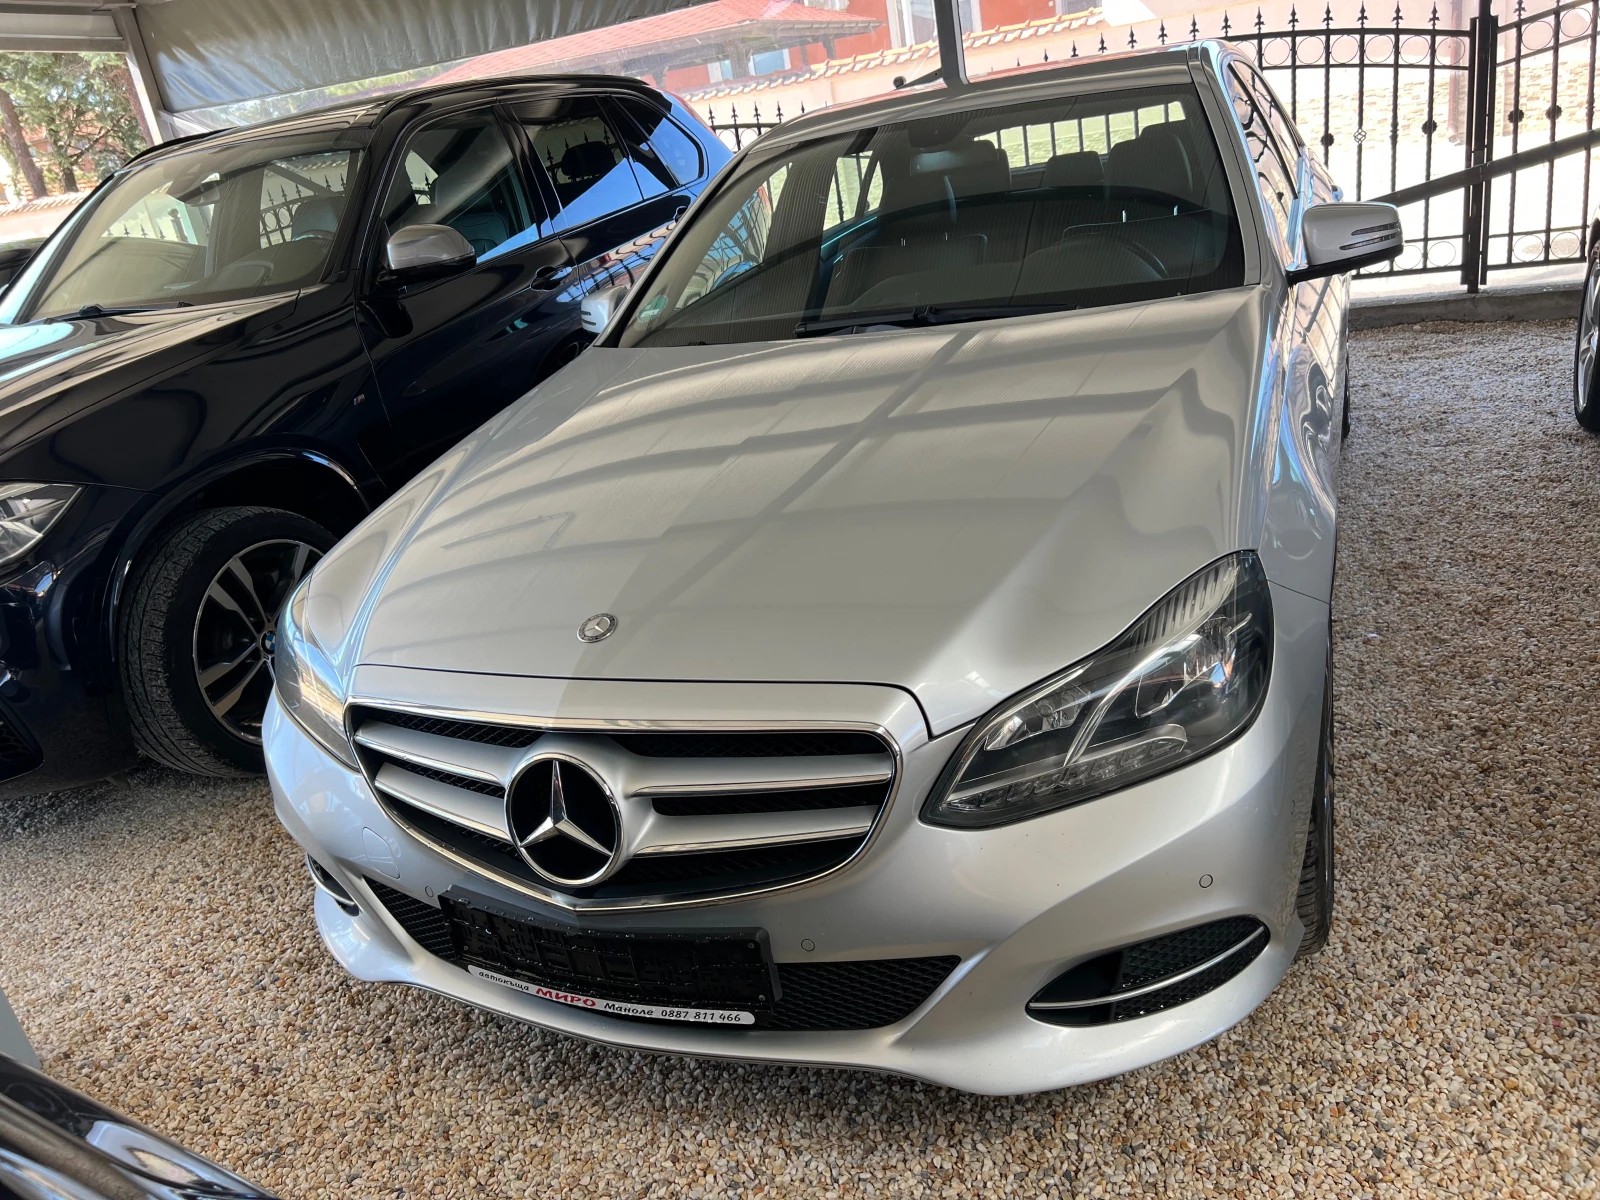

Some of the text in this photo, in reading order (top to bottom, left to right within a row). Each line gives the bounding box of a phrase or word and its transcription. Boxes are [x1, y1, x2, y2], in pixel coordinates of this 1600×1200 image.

[478, 970, 741, 1022] автокъща МИРО Маноле 0887 811 466
